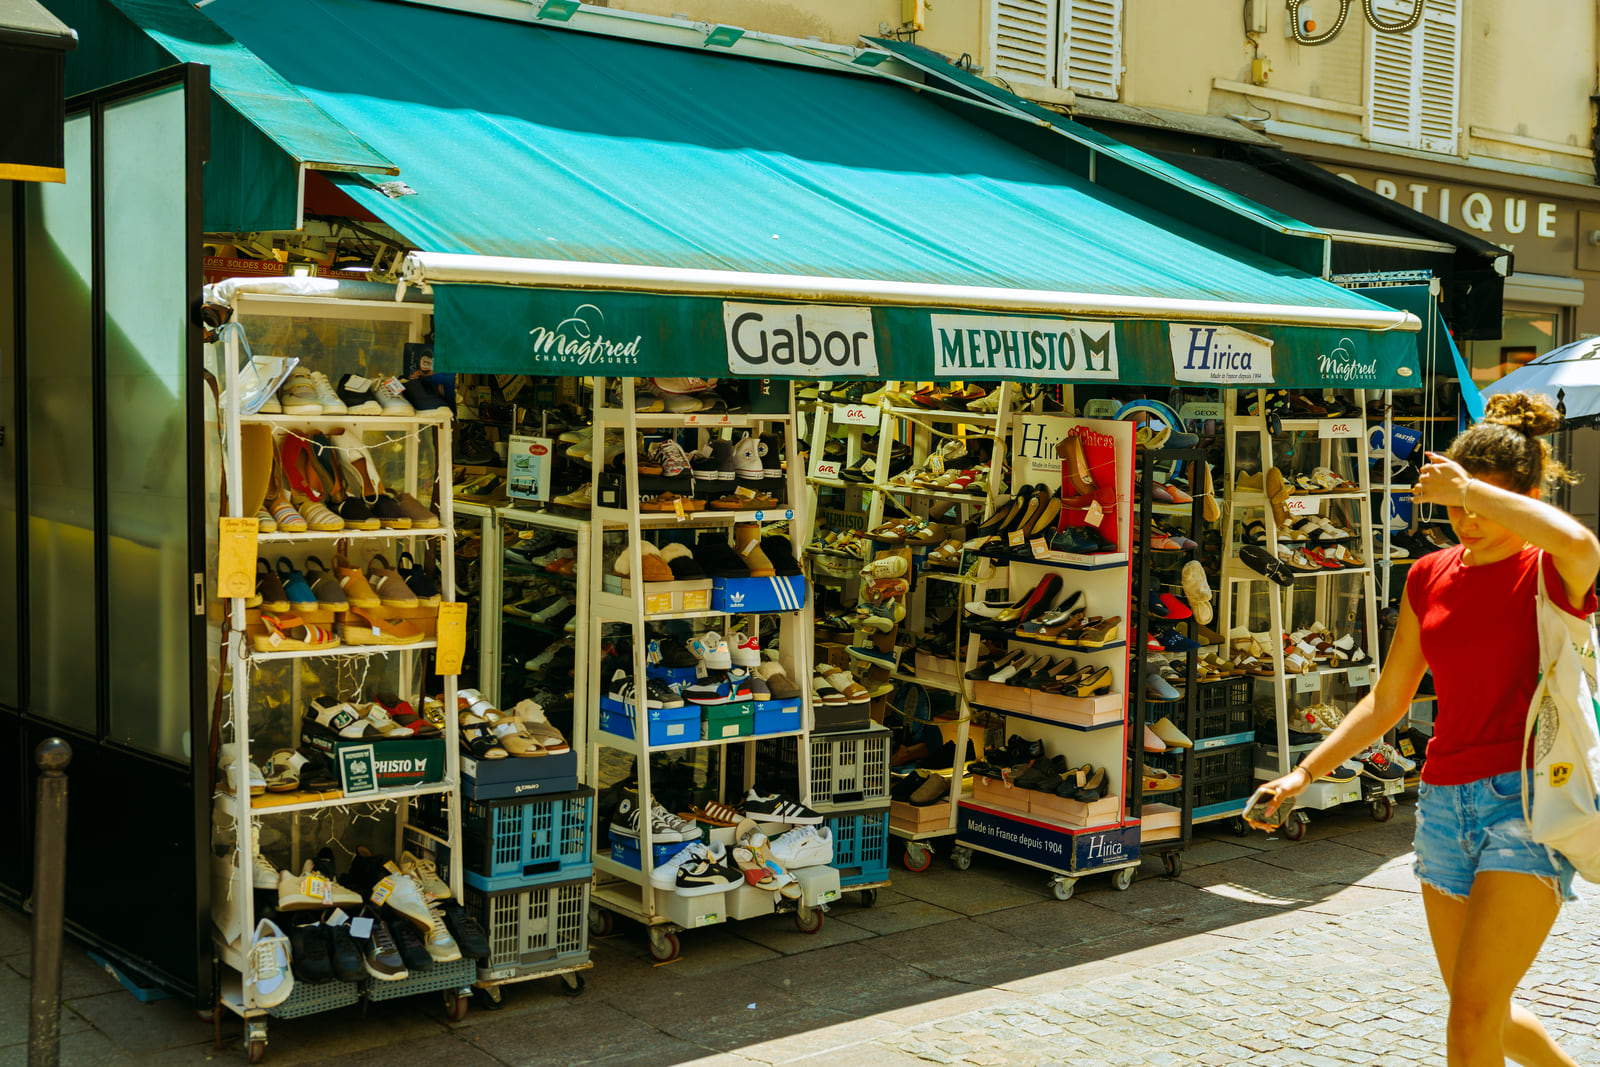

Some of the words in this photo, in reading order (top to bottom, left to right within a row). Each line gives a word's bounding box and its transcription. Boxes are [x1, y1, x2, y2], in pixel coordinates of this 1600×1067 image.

[227, 259, 259, 269] SOLDES
[262, 262, 284, 271] SOLD
[529, 326, 642, 365] Magfred
[731, 312, 868, 367] Gabor
[938, 327, 1076, 370] MEPHISTO
[1183, 327, 1252, 370] Hirica
[1317, 354, 1377, 381] Magfred
[847, 409, 867, 419] ara
[1332, 423, 1350, 433] ara
[1018, 423, 1060, 460] Hiri
[818, 465, 836, 474] ara
[1288, 501, 1306, 509] ara
[375, 759, 412, 773] PHISTO
[967, 819, 987, 834] Made
[987, 823, 995, 835] in
[995, 826, 1018, 842] France
[1018, 833, 1043, 851] depuis
[1044, 839, 1063, 855] 1904
[1087, 834, 1122, 859] Hirica
